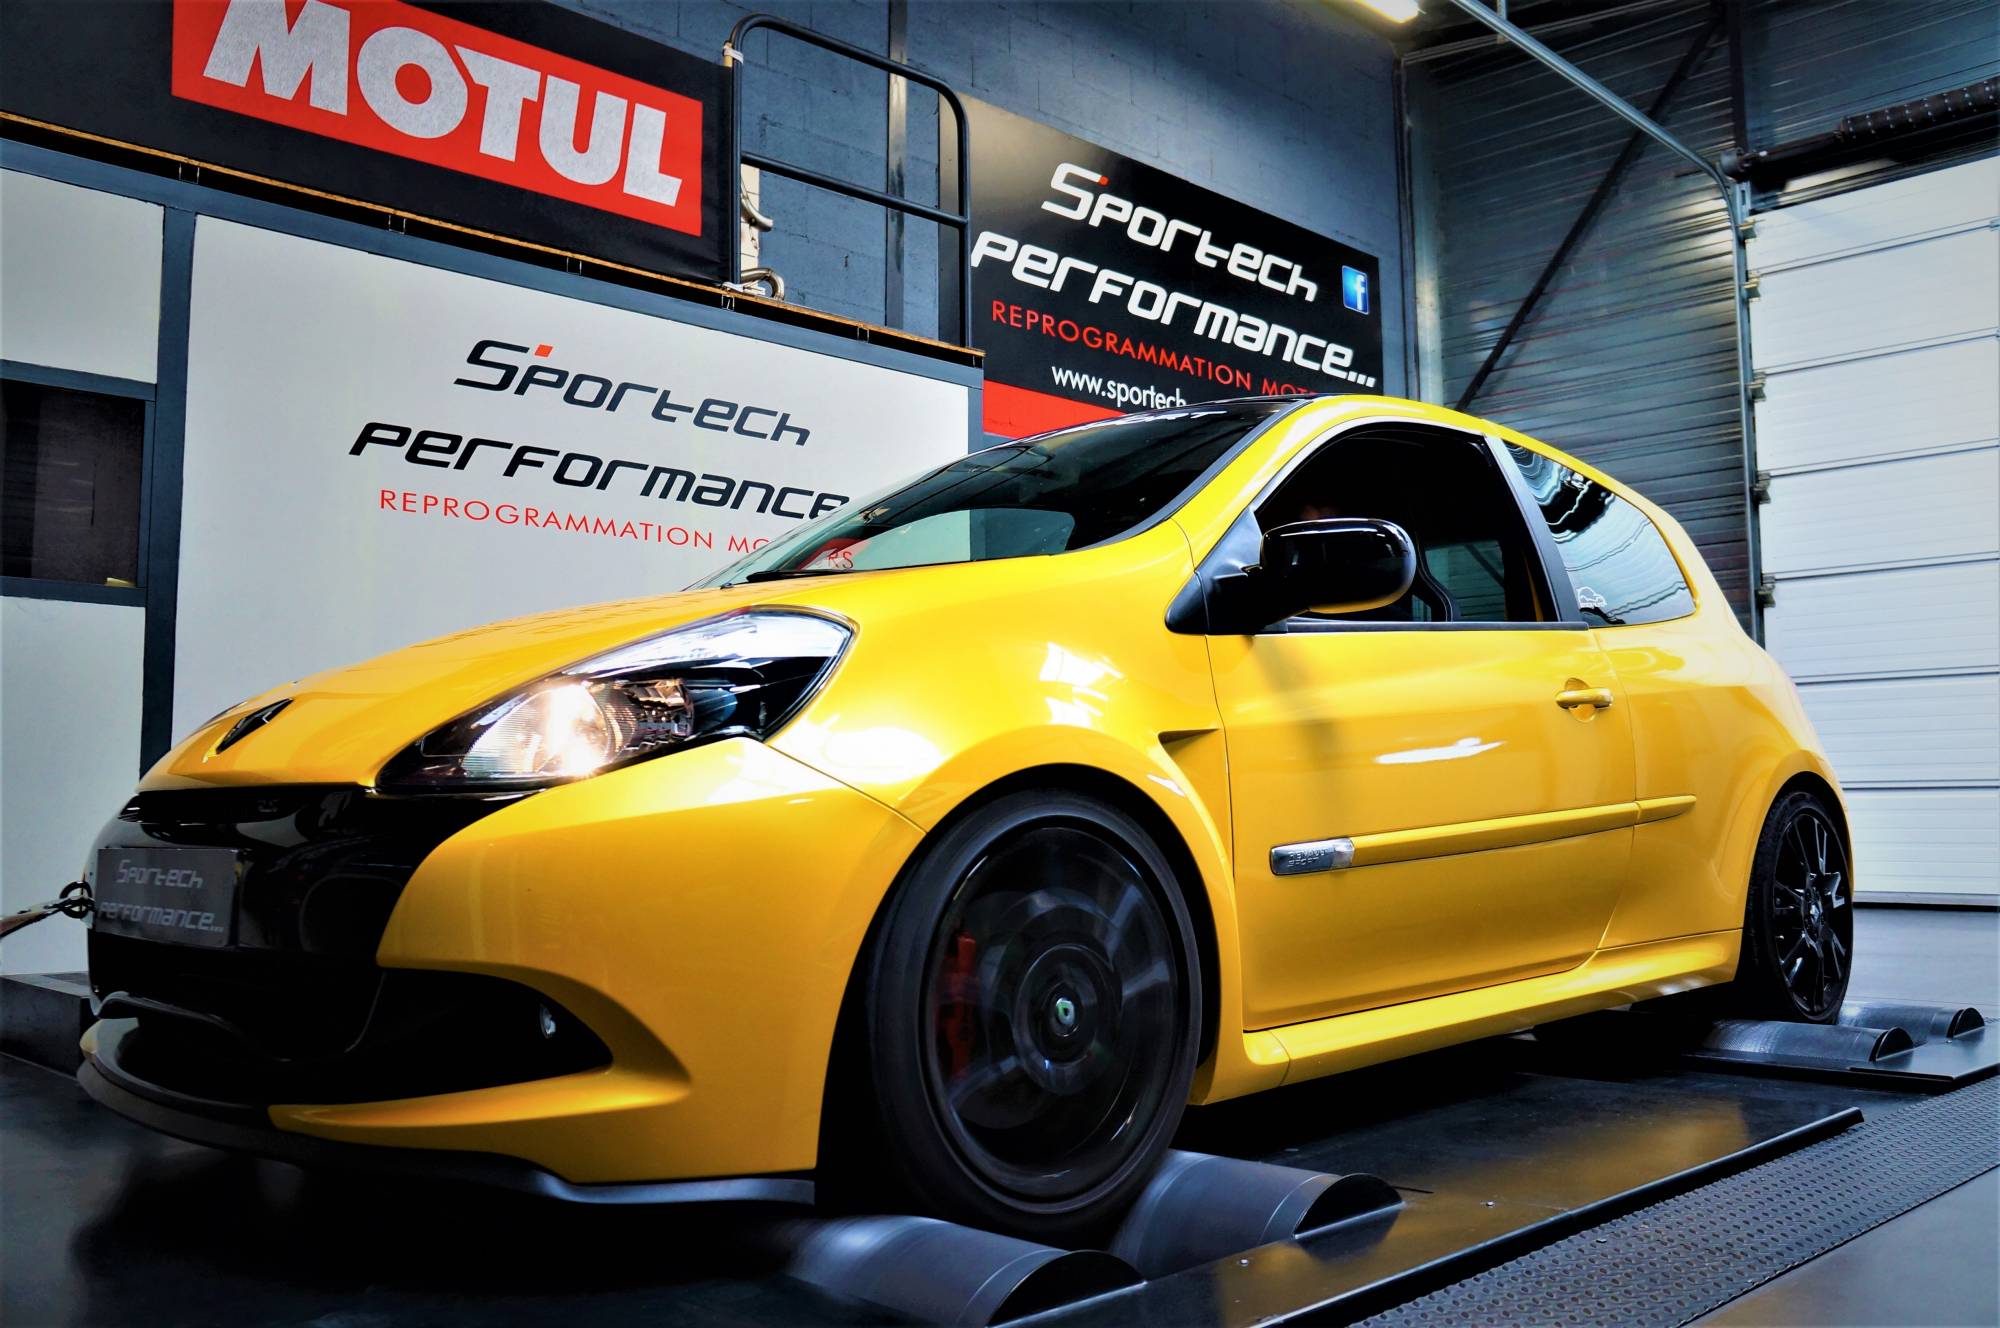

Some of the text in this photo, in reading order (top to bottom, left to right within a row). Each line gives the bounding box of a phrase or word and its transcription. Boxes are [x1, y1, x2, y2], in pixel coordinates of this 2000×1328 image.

[204, 0, 682, 206] MOTUL
[991, 300, 1252, 392] REPROGRAMMATION
[380, 489, 713, 550] REPROGRAMMATION
